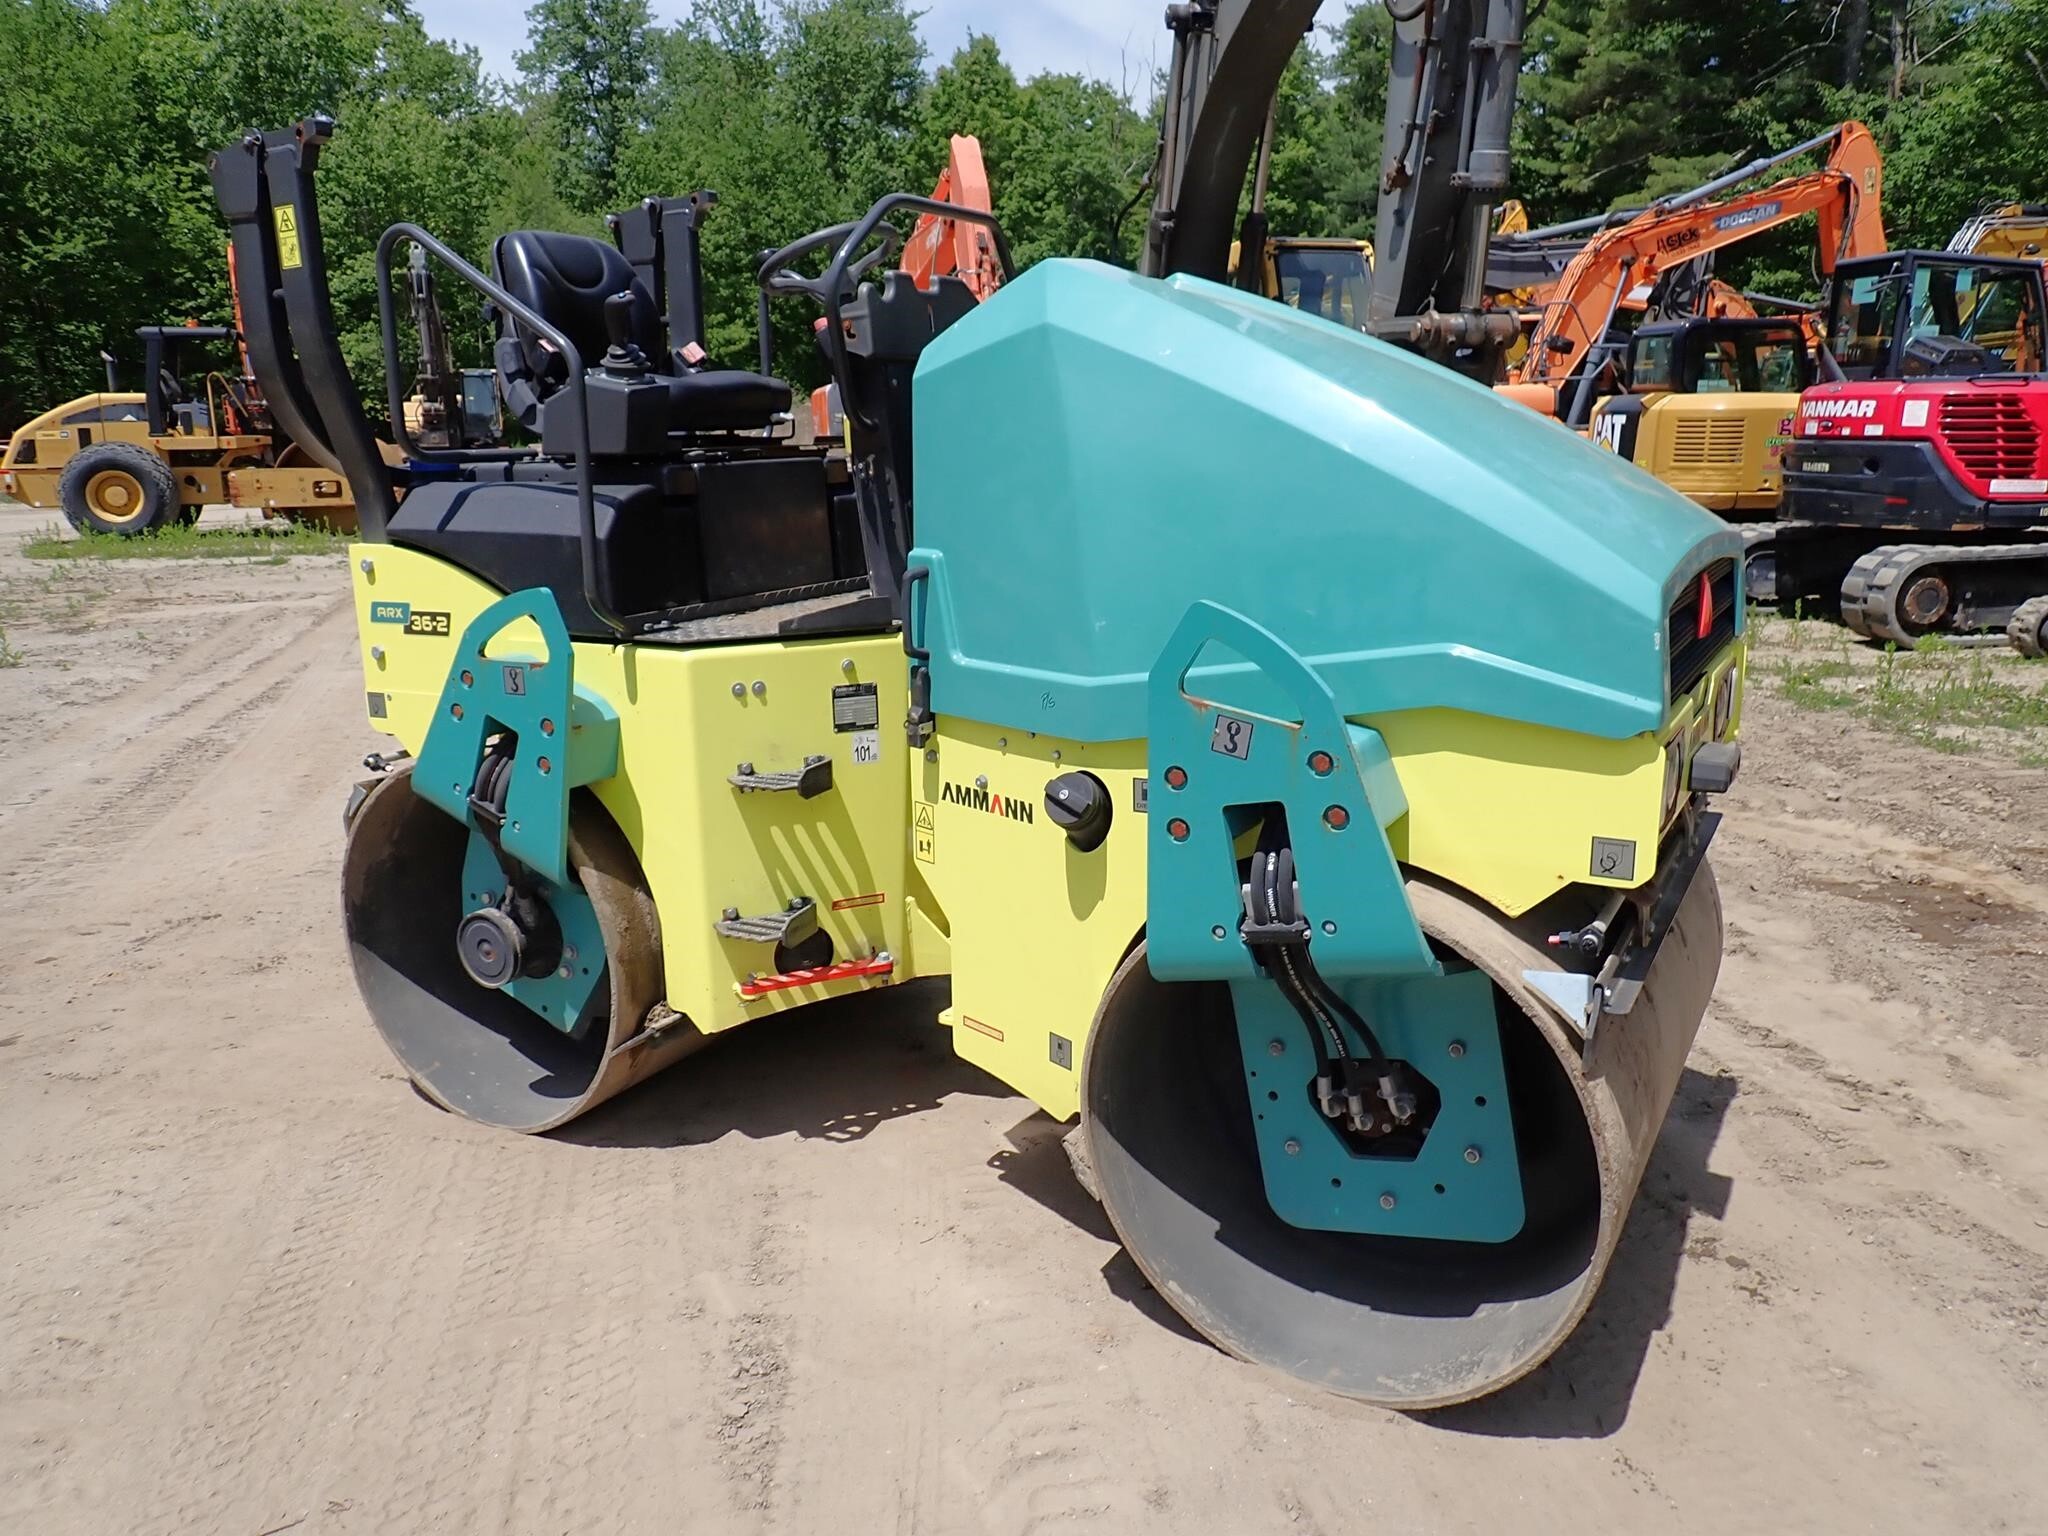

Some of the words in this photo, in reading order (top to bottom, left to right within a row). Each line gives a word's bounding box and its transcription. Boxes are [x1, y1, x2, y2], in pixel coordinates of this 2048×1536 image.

[1719, 204, 1776, 229] DOOSAN
[1801, 400, 1877, 418] YANMAR
[1593, 413, 1627, 455] CAT
[376, 606, 404, 619] ARX
[411, 615, 448, 632] 36-2
[854, 745, 871, 762] 101
[941, 781, 1033, 825] AMMANN
